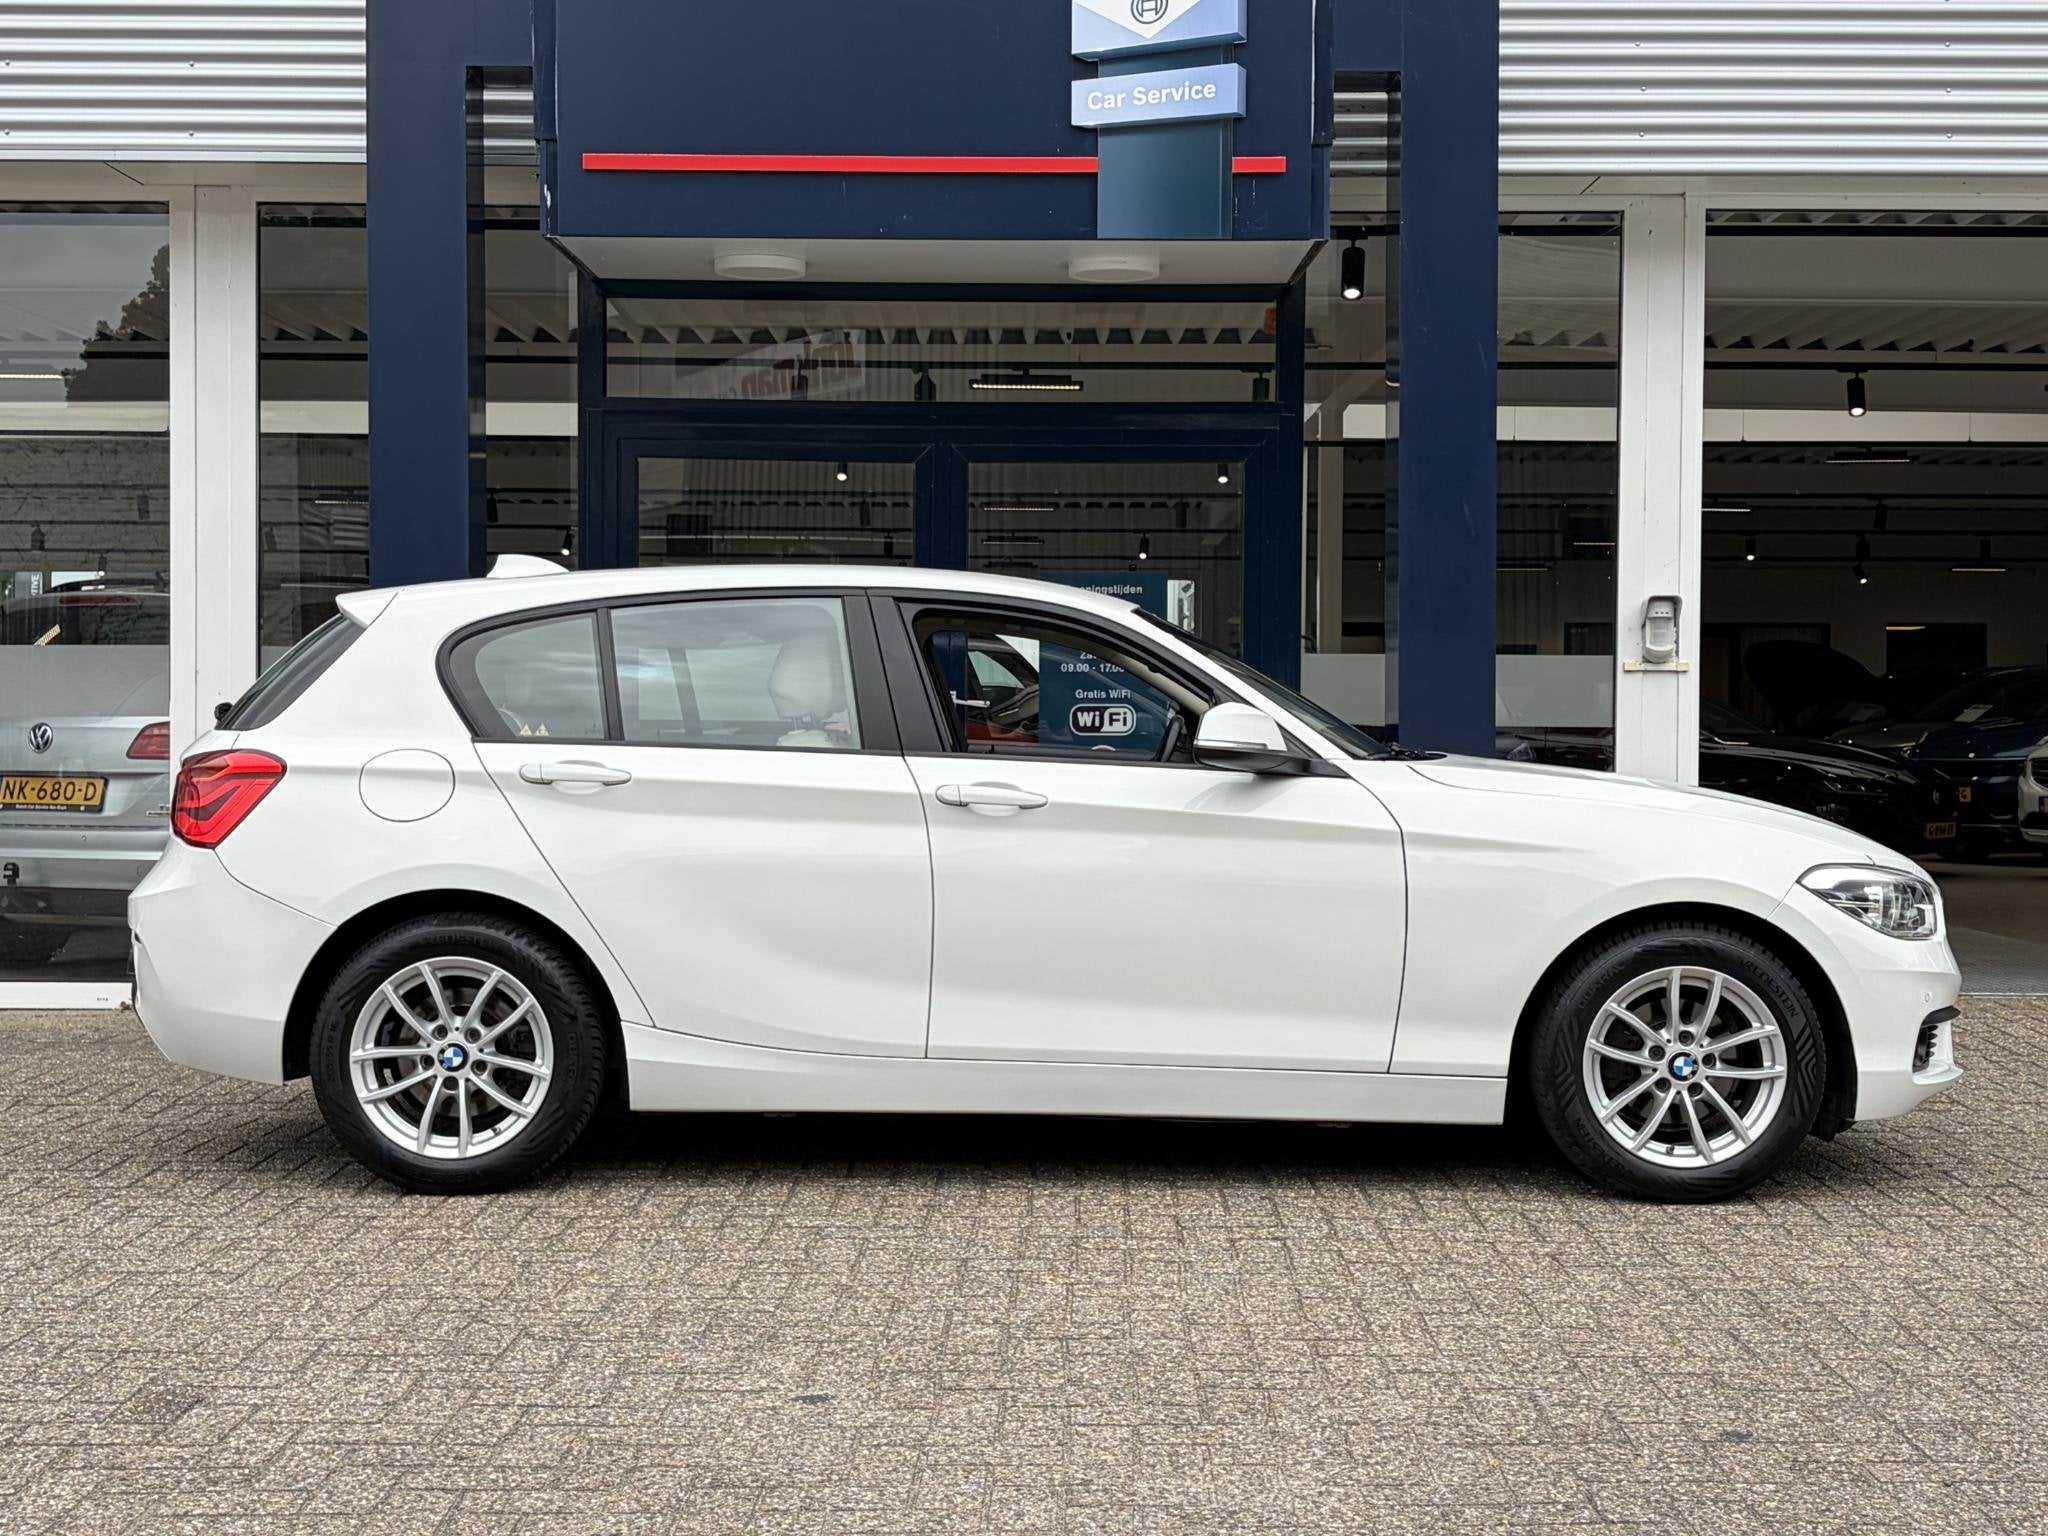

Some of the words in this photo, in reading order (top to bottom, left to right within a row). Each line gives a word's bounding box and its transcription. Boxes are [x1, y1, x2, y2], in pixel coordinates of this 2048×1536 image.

[1087, 91, 1124, 110] Car
[1133, 81, 1216, 106] Service
[1080, 584, 1143, 595] ningstijden
[1060, 663, 1089, 673] 09.00
[1075, 688, 1106, 699] Gratis
[1109, 688, 1131, 699] WiFi
[3, 780, 97, 801] NK-680-D
